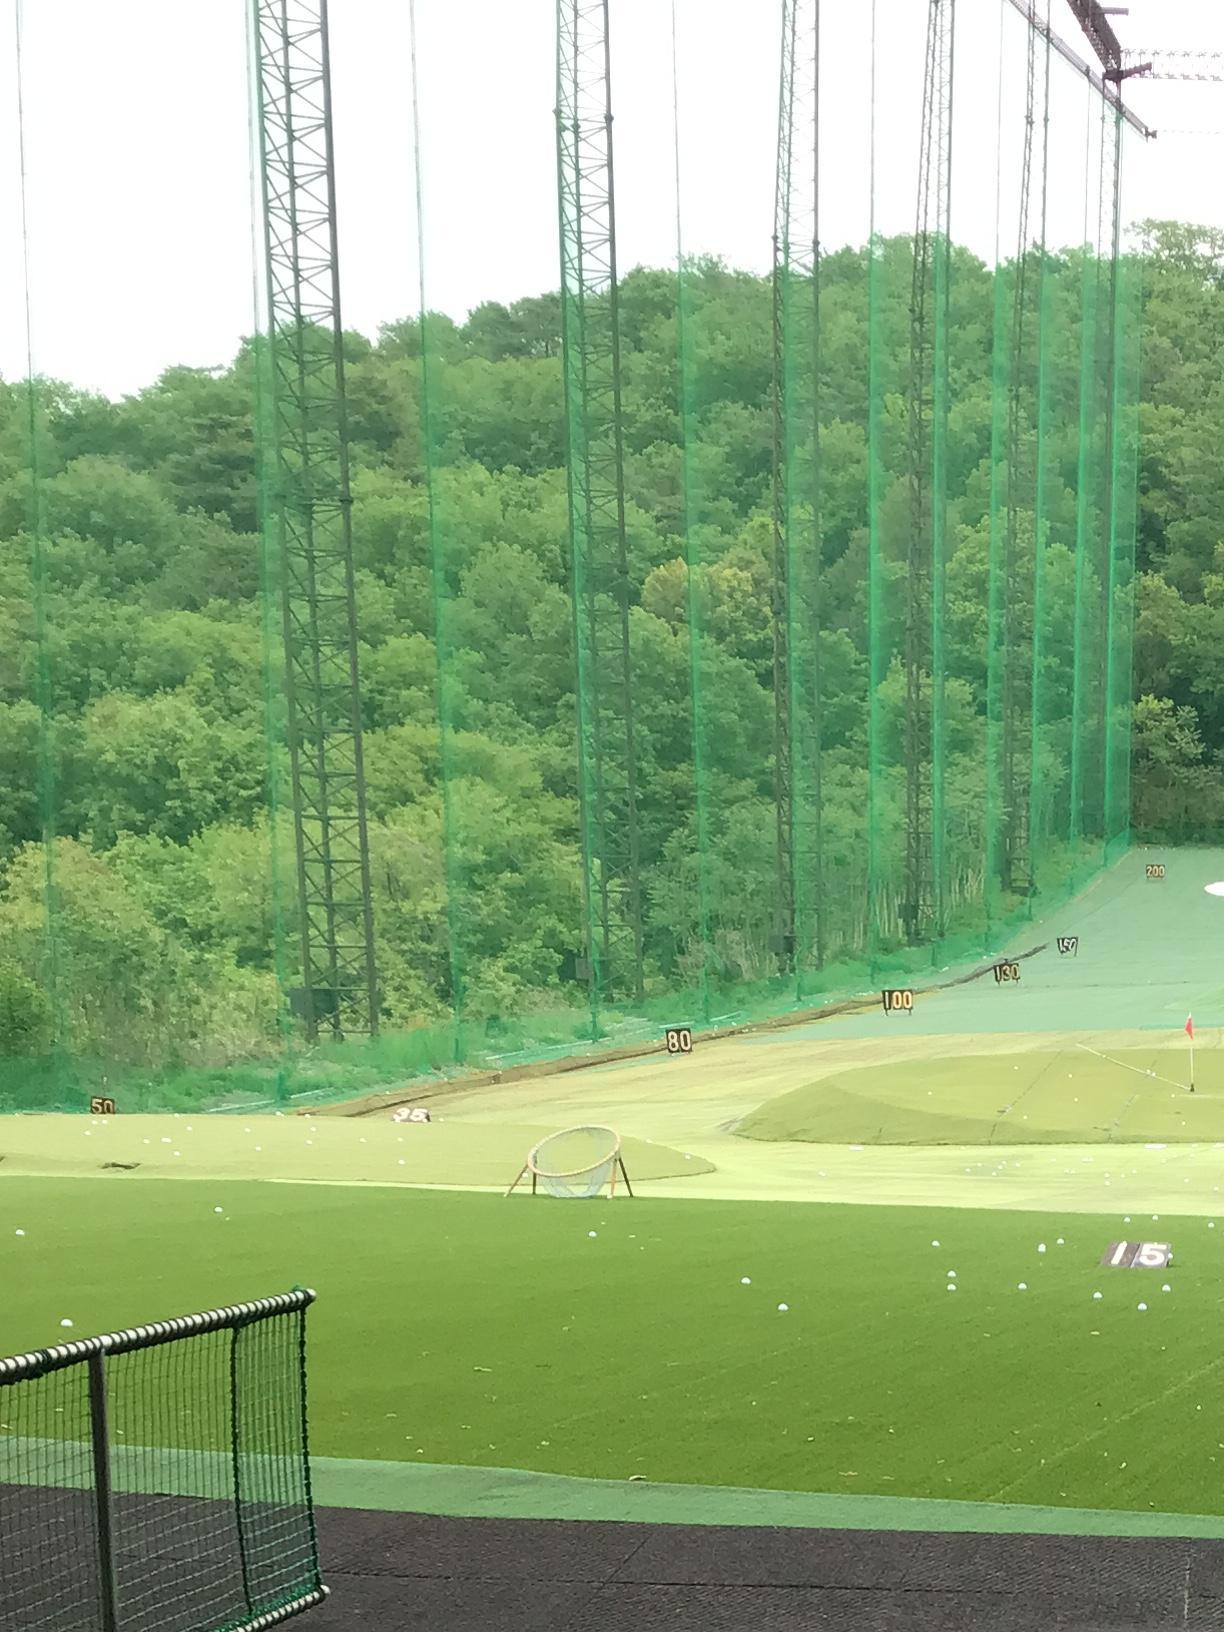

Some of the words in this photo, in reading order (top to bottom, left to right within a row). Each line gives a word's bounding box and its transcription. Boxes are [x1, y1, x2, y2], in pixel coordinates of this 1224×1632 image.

[1146, 864, 1165, 877] 200
[1058, 938, 1077, 952] 150
[995, 964, 1020, 981] 130
[885, 991, 912, 1009] 100
[668, 1030, 691, 1052] 80
[91, 1098, 113, 1114] 50
[395, 1107, 428, 1122] 35
[1110, 1240, 1168, 1266] 15
